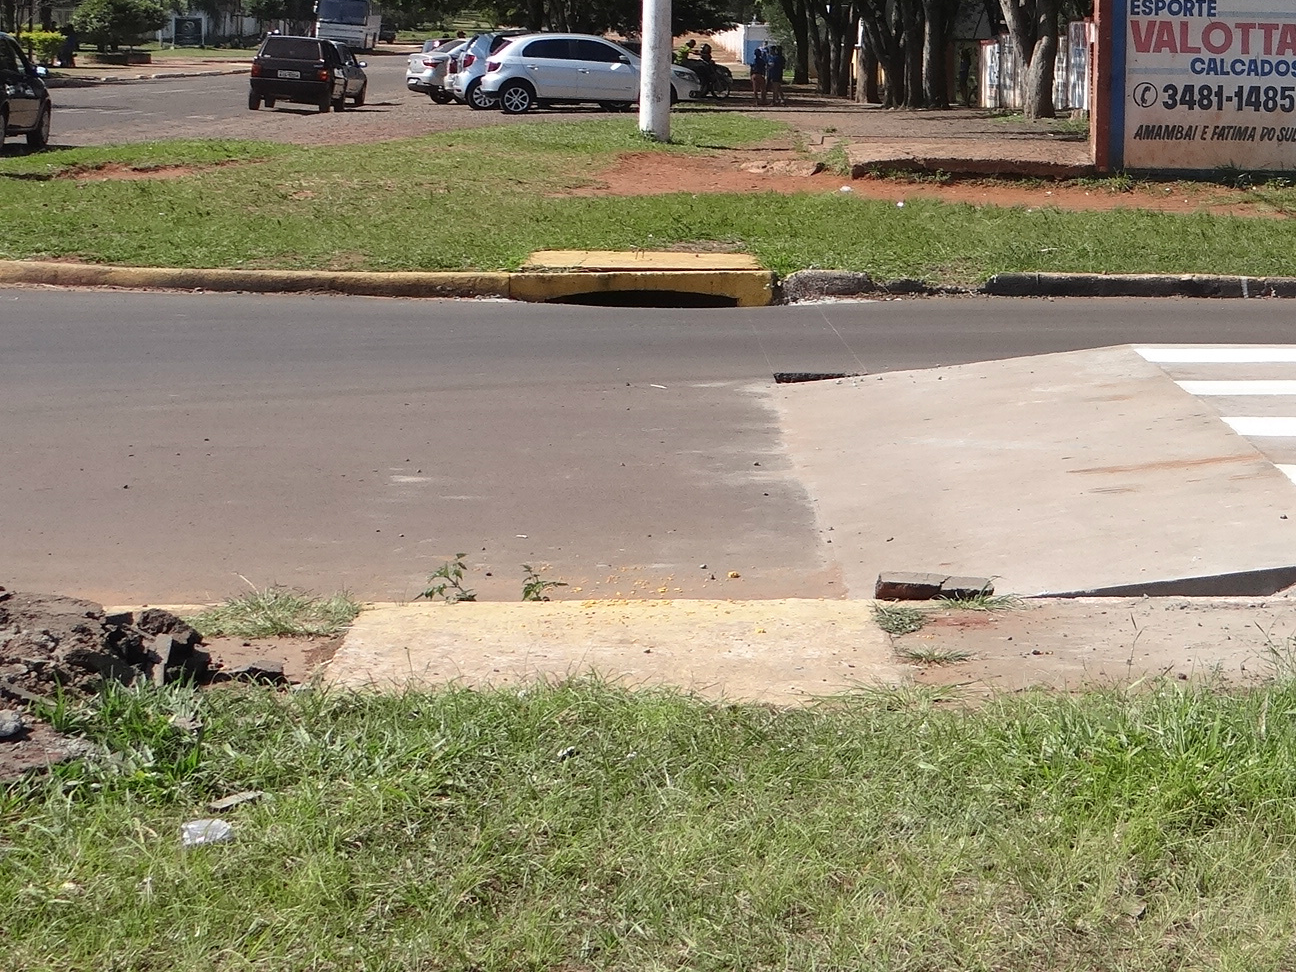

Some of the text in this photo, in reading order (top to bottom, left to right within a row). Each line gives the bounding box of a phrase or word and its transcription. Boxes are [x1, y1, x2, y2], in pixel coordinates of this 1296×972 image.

[1162, 83, 1295, 113] 3481-1485
[1133, 124, 1198, 140] AMAMBAI
[1200, 125, 1209, 141] E
[1210, 126, 1256, 142] FATIMA
[1259, 127, 1276, 141] DO
